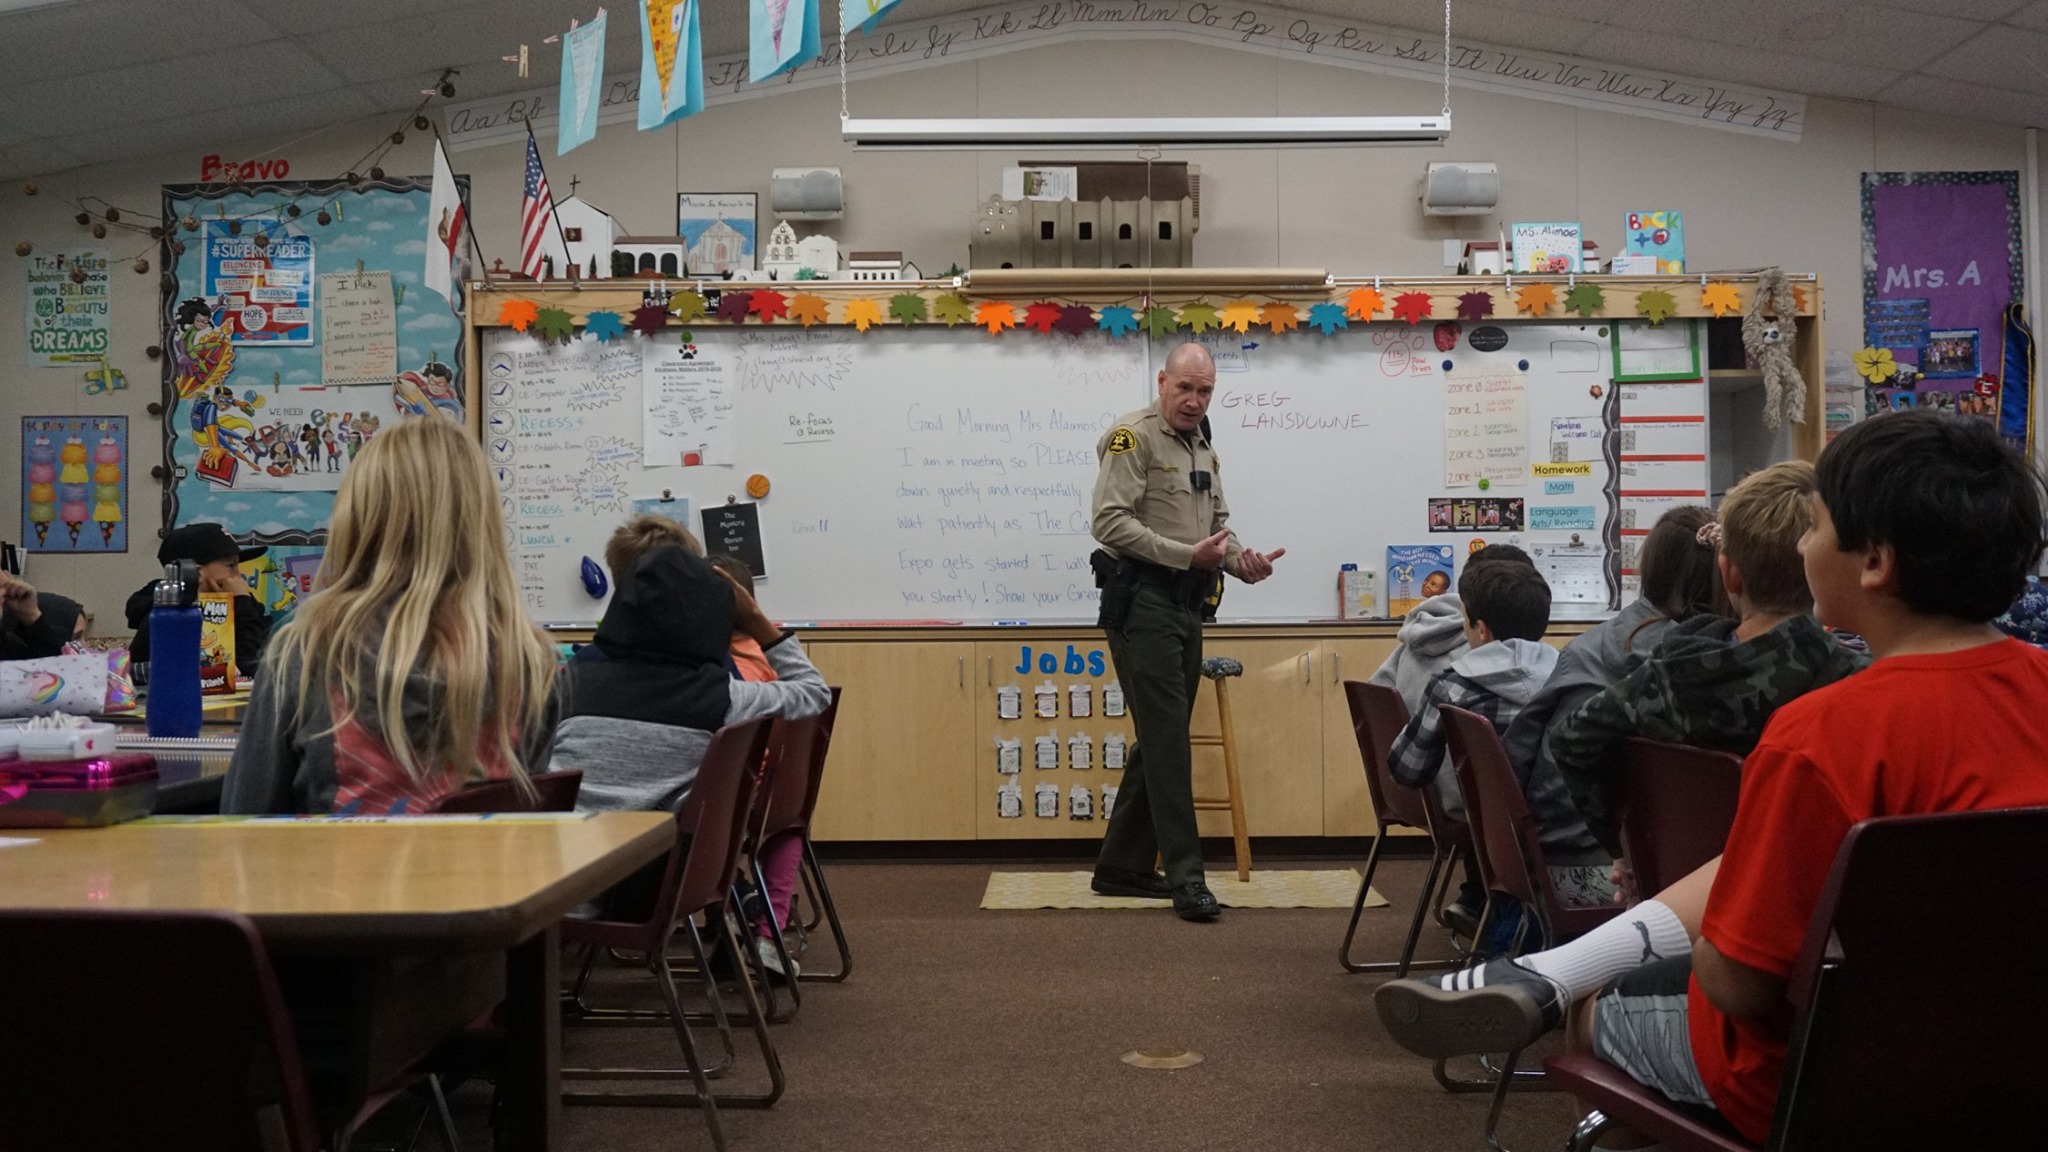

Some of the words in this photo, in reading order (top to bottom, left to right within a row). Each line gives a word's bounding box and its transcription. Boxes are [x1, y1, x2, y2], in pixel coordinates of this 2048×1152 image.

[201, 154, 289, 181] Bravo
[1629, 211, 1680, 230] BACK
[211, 244, 306, 258] #SUPERREADER
[1883, 264, 1948, 293] Mrs.
[1957, 260, 1981, 287] A
[244, 310, 263, 318] HOPE
[32, 330, 106, 350] DREAMS
[1209, 347, 1239, 360] ecess
[1221, 391, 1290, 408] GREG
[269, 408, 282, 416] WE
[283, 408, 303, 416] NEED
[907, 403, 943, 433] Good
[958, 407, 1010, 442] Morning
[1241, 412, 1370, 430] LANSDOWNE
[897, 448, 915, 467] I
[961, 454, 1003, 475] meeting
[1028, 443, 1095, 466] PLEASE
[1475, 448, 1484, 460] 3
[1534, 465, 1590, 475] Homework
[896, 483, 929, 498] down
[937, 482, 981, 507] quietly
[988, 484, 1009, 496] and
[1549, 483, 1574, 491] Math
[1530, 508, 1579, 517] Language
[940, 511, 996, 537] patiently
[1003, 518, 1022, 529] as
[1030, 510, 1062, 530] The
[1555, 520, 1594, 529] Reading
[943, 554, 974, 577] gets
[204, 601, 228, 616] MAN
[1015, 645, 1105, 677] Jobs
